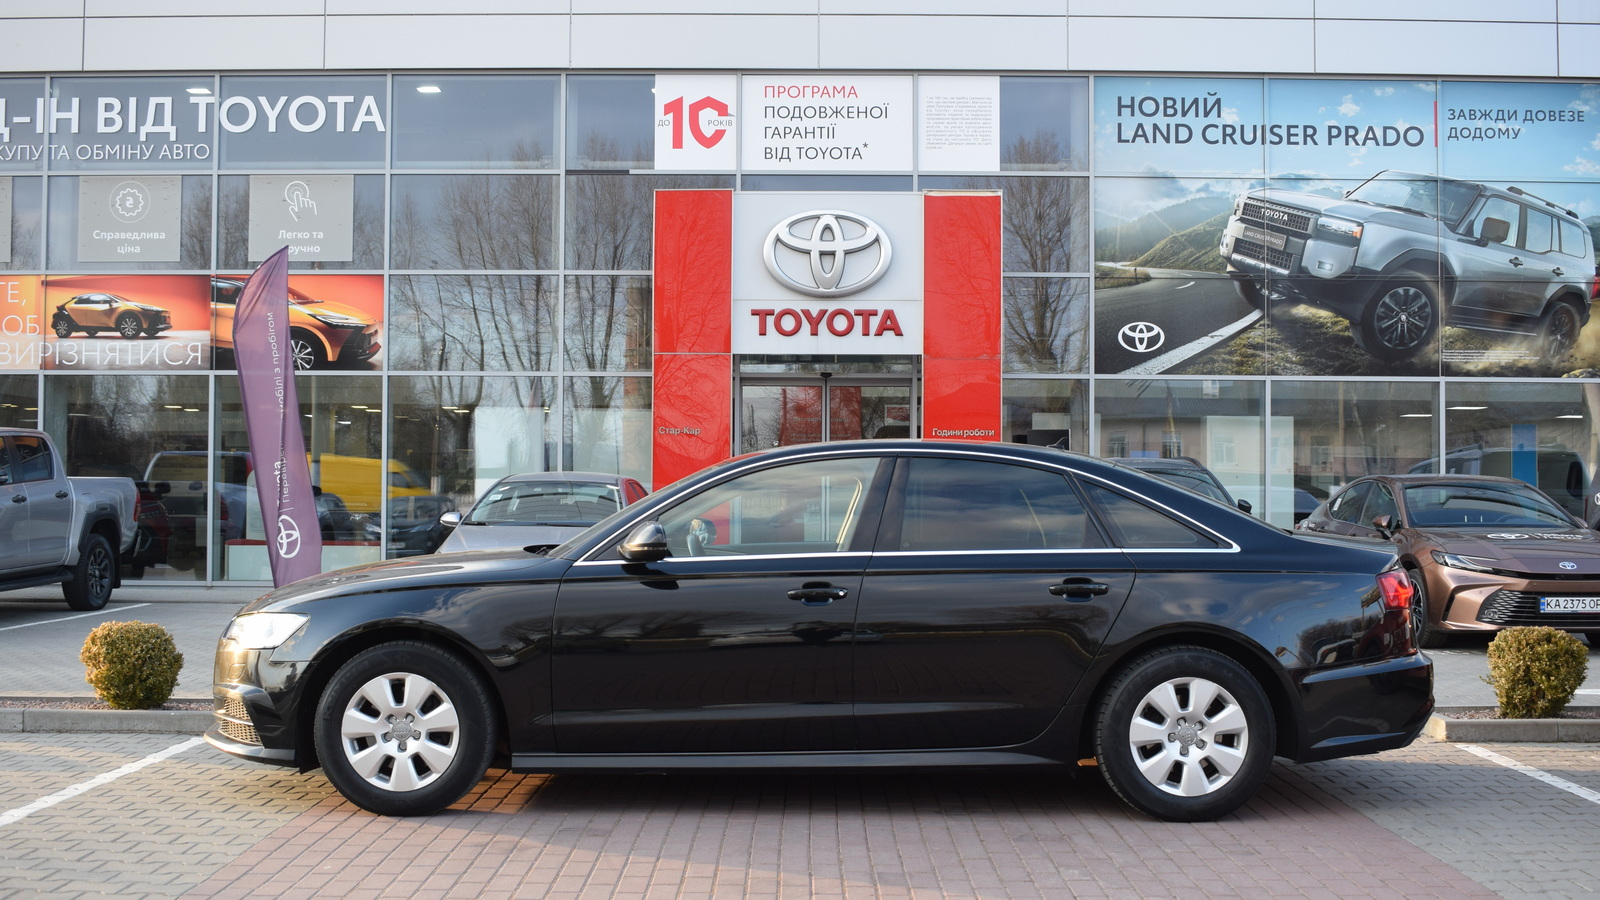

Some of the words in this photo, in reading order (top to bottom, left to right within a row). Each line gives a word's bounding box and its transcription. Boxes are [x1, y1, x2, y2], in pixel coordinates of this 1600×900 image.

[764, 85, 858, 99] ПРОГРАМА
[764, 103, 889, 121] ПОДОВЖЕНОЇ
[1117, 92, 1222, 118] НОВИЙ
[0, 97, 80, 142] -ІН
[97, 97, 177, 142] ВІД
[190, 95, 386, 133] TOYOTA
[707, 119, 733, 127] РОКІВ
[1447, 109, 1518, 124] ЗАВЖДИ
[1522, 109, 1585, 124] ДОВЕЗЕ
[764, 124, 836, 139] ГАРАНТІЇ
[1117, 122, 1193, 144] LAND
[1201, 123, 1318, 146] CRUISER
[1327, 125, 1424, 147] PRADO
[1447, 126, 1521, 142] ДОДОМУ
[49, 145, 70, 160] ТА
[76, 144, 154, 160] ОБМІНУ
[159, 143, 210, 159] АВТО
[764, 147, 791, 162] ВІД
[1260, 209, 1288, 221] TOYOTA
[93, 230, 166, 241] Справедлива
[278, 230, 309, 240] Легко
[312, 232, 324, 240] та
[117, 243, 141, 254] ціна
[282, 245, 320, 254] ручно
[751, 308, 903, 337] TOYOTA
[267, 312, 280, 365] пробігом
[0, 342, 202, 365] ВИРІЗНЯТИСЯ
[658, 426, 701, 436] Стар-Кар
[932, 428, 963, 437] Години
[963, 428, 995, 438] роботи
[1546, 599, 1561, 609] KA
[1563, 599, 1587, 609] 2375
